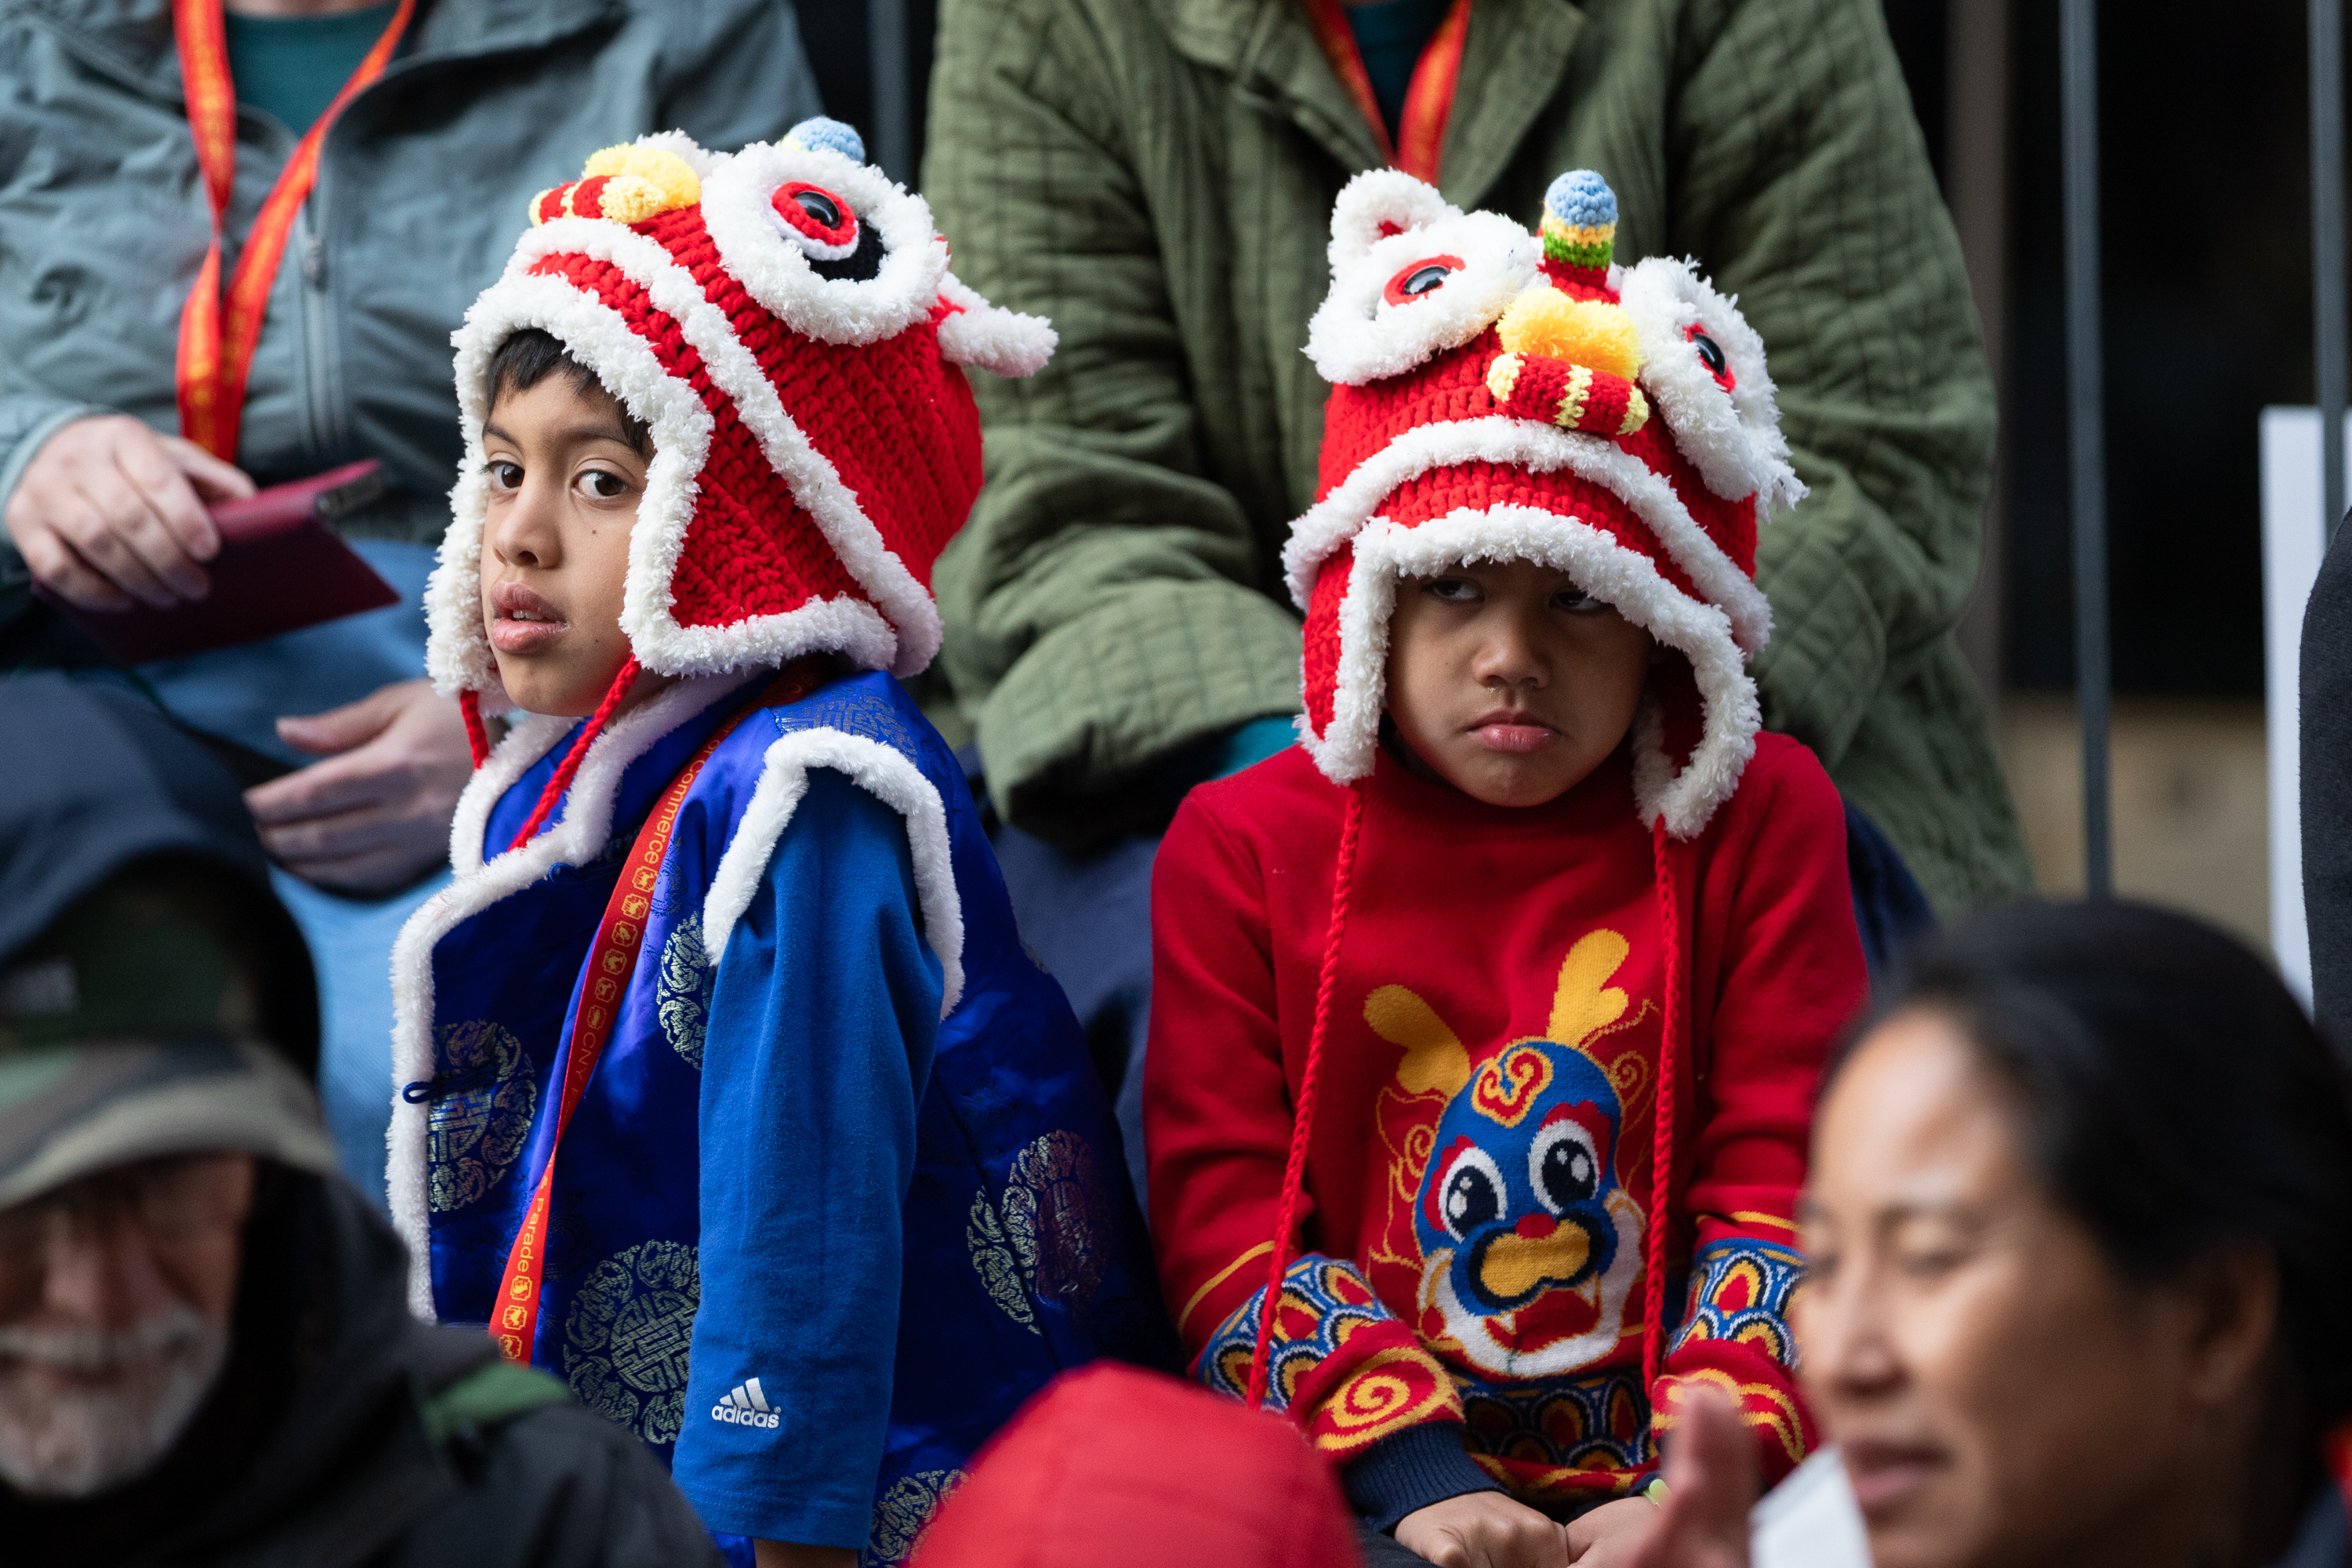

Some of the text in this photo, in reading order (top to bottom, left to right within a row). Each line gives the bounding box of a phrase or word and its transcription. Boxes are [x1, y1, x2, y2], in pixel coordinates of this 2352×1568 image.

[644, 760, 706, 864] Commerce
[575, 1032, 596, 1081] CNY
[517, 1198, 544, 1272] Parade
[711, 1405, 779, 1428] adidas
